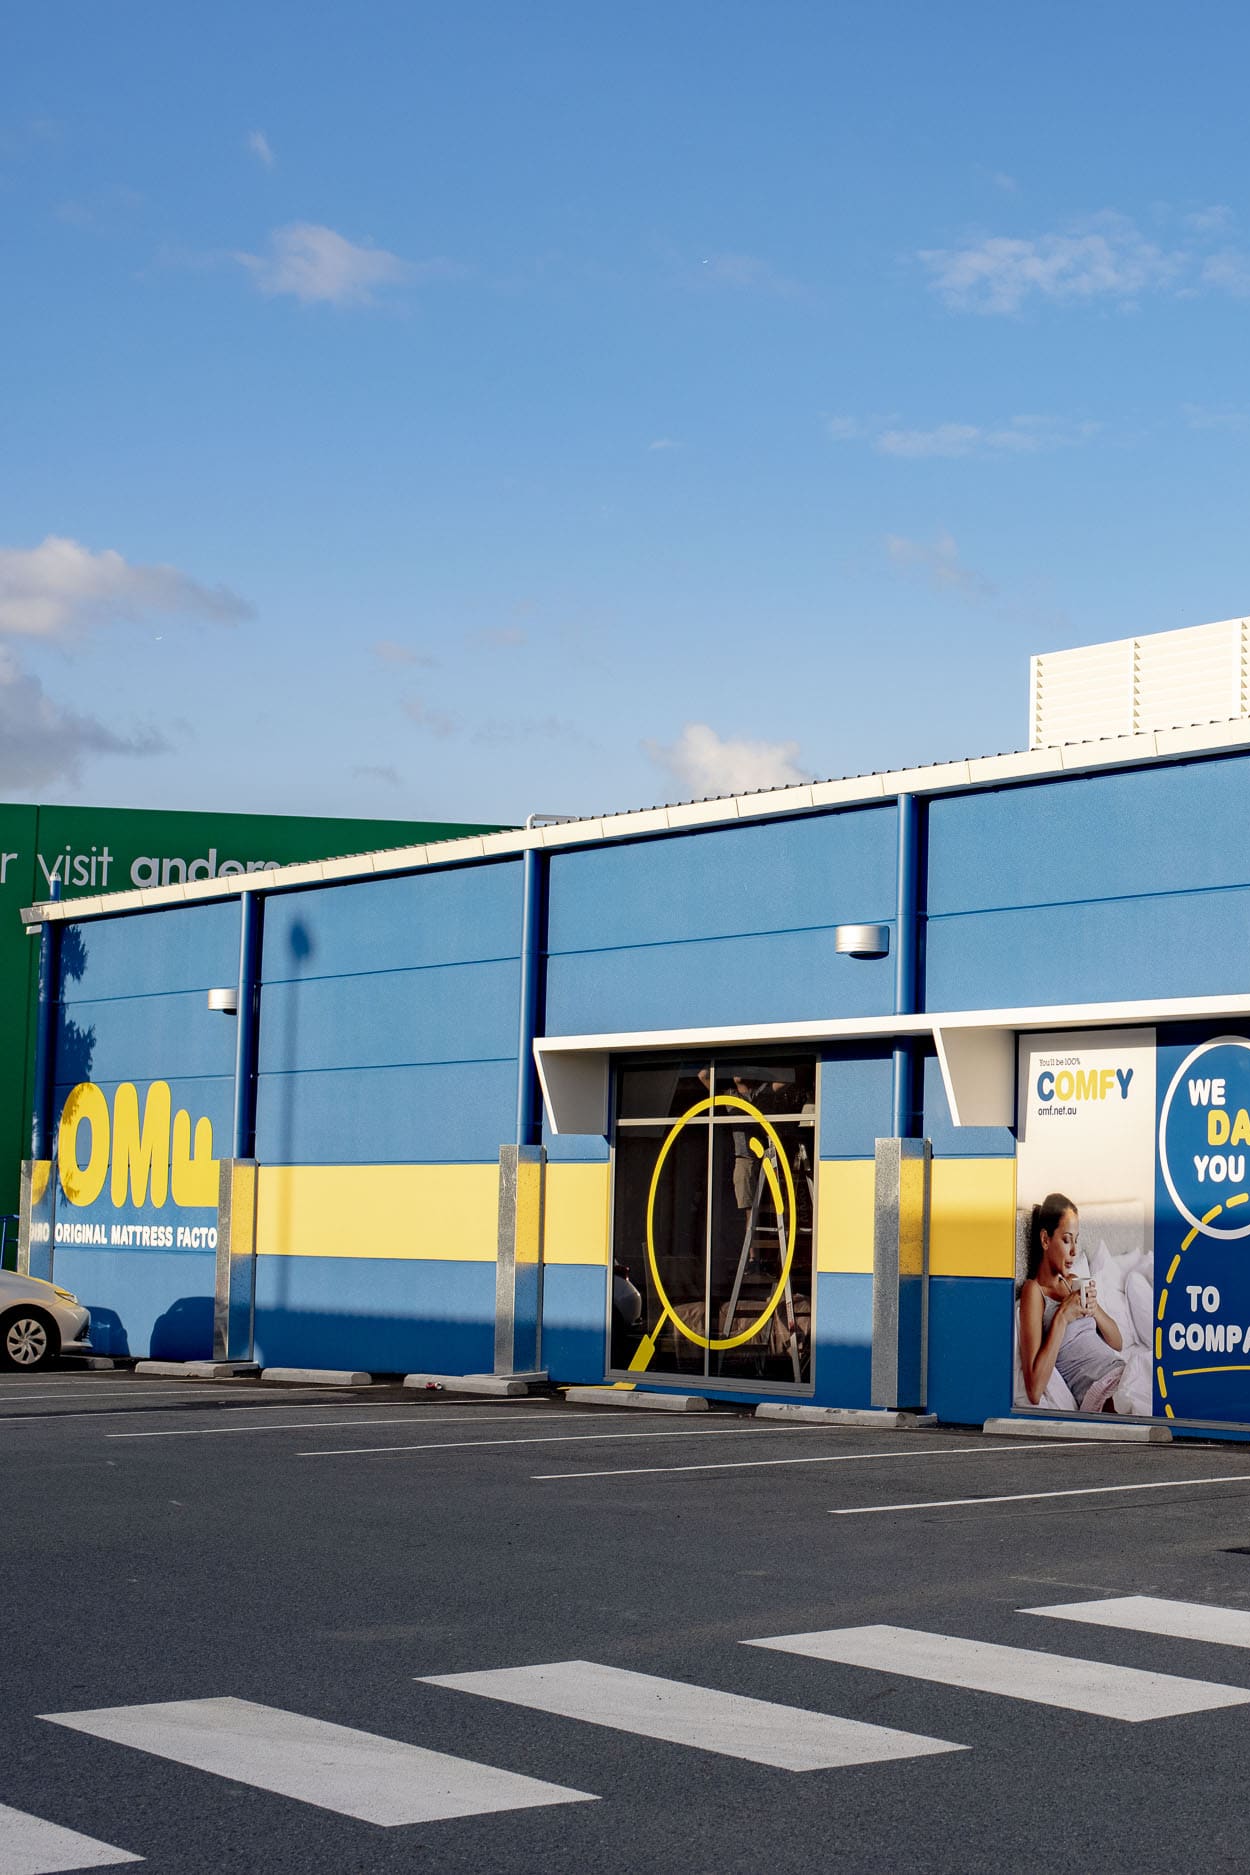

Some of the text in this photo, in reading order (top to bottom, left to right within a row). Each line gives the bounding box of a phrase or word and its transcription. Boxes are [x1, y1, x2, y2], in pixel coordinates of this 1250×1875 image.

[37, 845, 114, 886] visit
[1056, 1058, 1064, 1066] be
[1064, 1057, 1081, 1066] 100%
[1037, 1068, 1134, 1102] COMFY
[1188, 1078, 1226, 1106] WE
[1038, 1105, 1077, 1116] omf.net.au
[1193, 1155, 1245, 1183] YOU
[54, 1223, 107, 1244] ORIGINAL
[110, 1224, 173, 1247] MATTRESS
[176, 1226, 218, 1249] FACTO
[1186, 1285, 1220, 1313] TO
